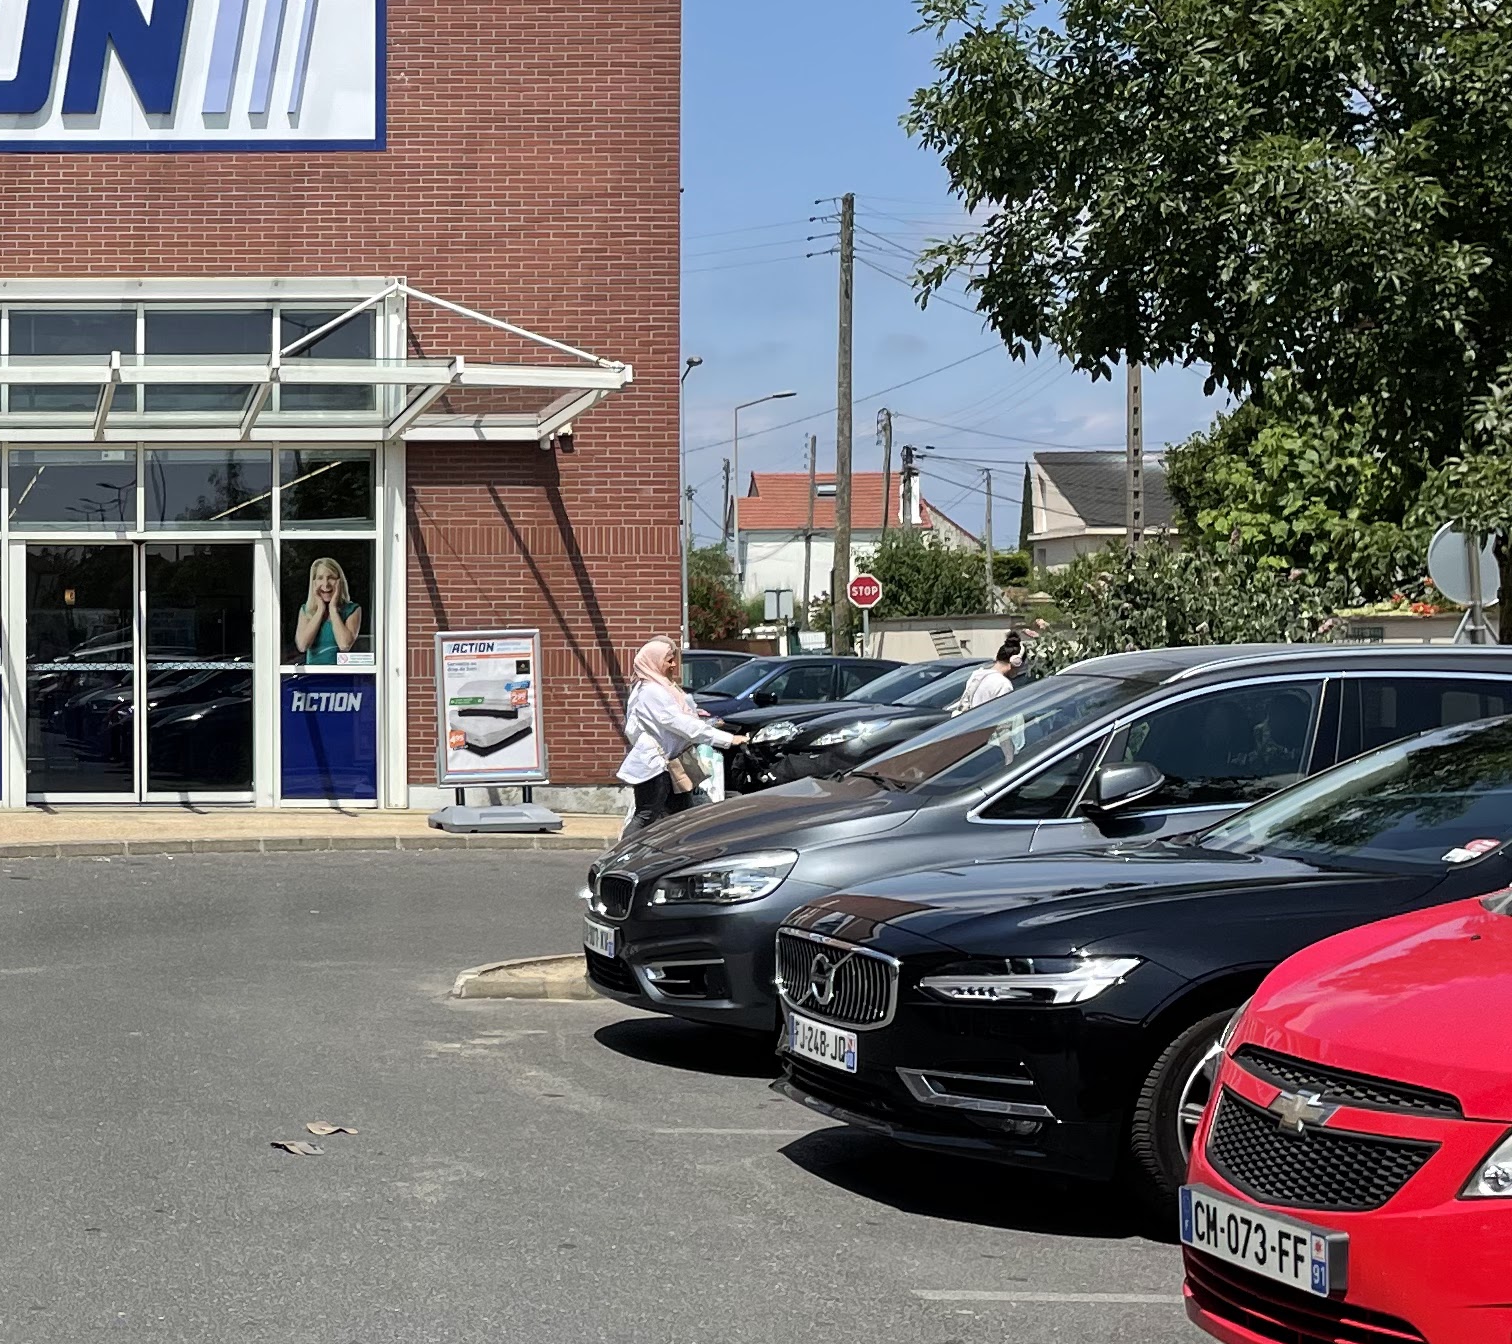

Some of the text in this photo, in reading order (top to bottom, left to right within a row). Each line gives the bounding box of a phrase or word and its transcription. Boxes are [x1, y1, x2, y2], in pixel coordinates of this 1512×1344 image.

[851, 585, 879, 597] STOP
[451, 642, 495, 654] ACTION
[291, 692, 363, 712] ACTION
[1194, 1200, 1307, 1279] CM-073-FF
[1312, 1264, 1325, 1287] 91
